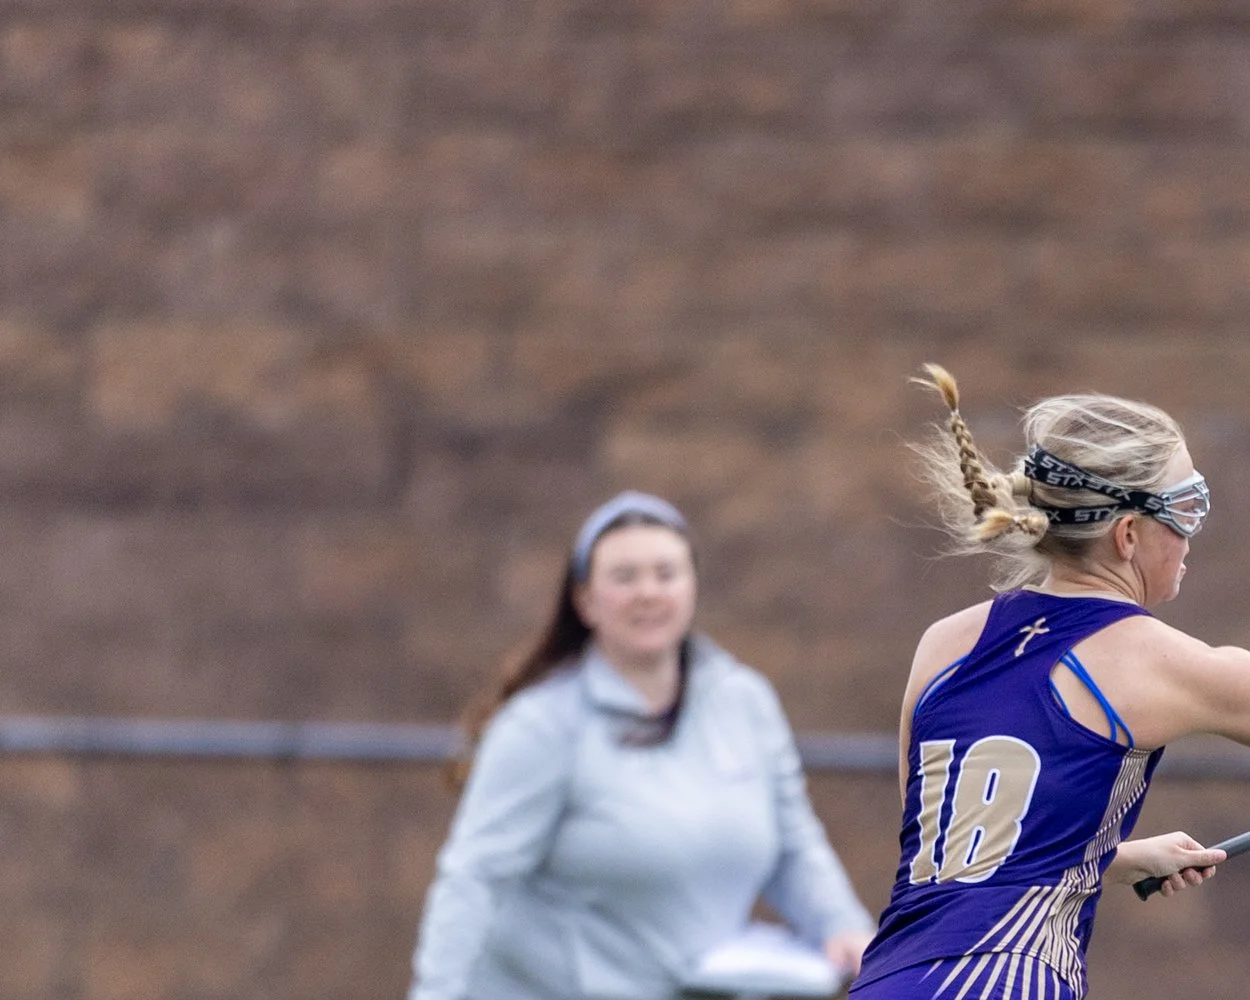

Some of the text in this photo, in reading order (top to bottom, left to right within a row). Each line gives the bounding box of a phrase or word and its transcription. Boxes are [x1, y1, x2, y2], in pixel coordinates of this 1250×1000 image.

[1046, 471, 1084, 487] STX
[1085, 478, 1130, 501] STX
[1075, 506, 1119, 522] STX
[909, 735, 1041, 885] 18
